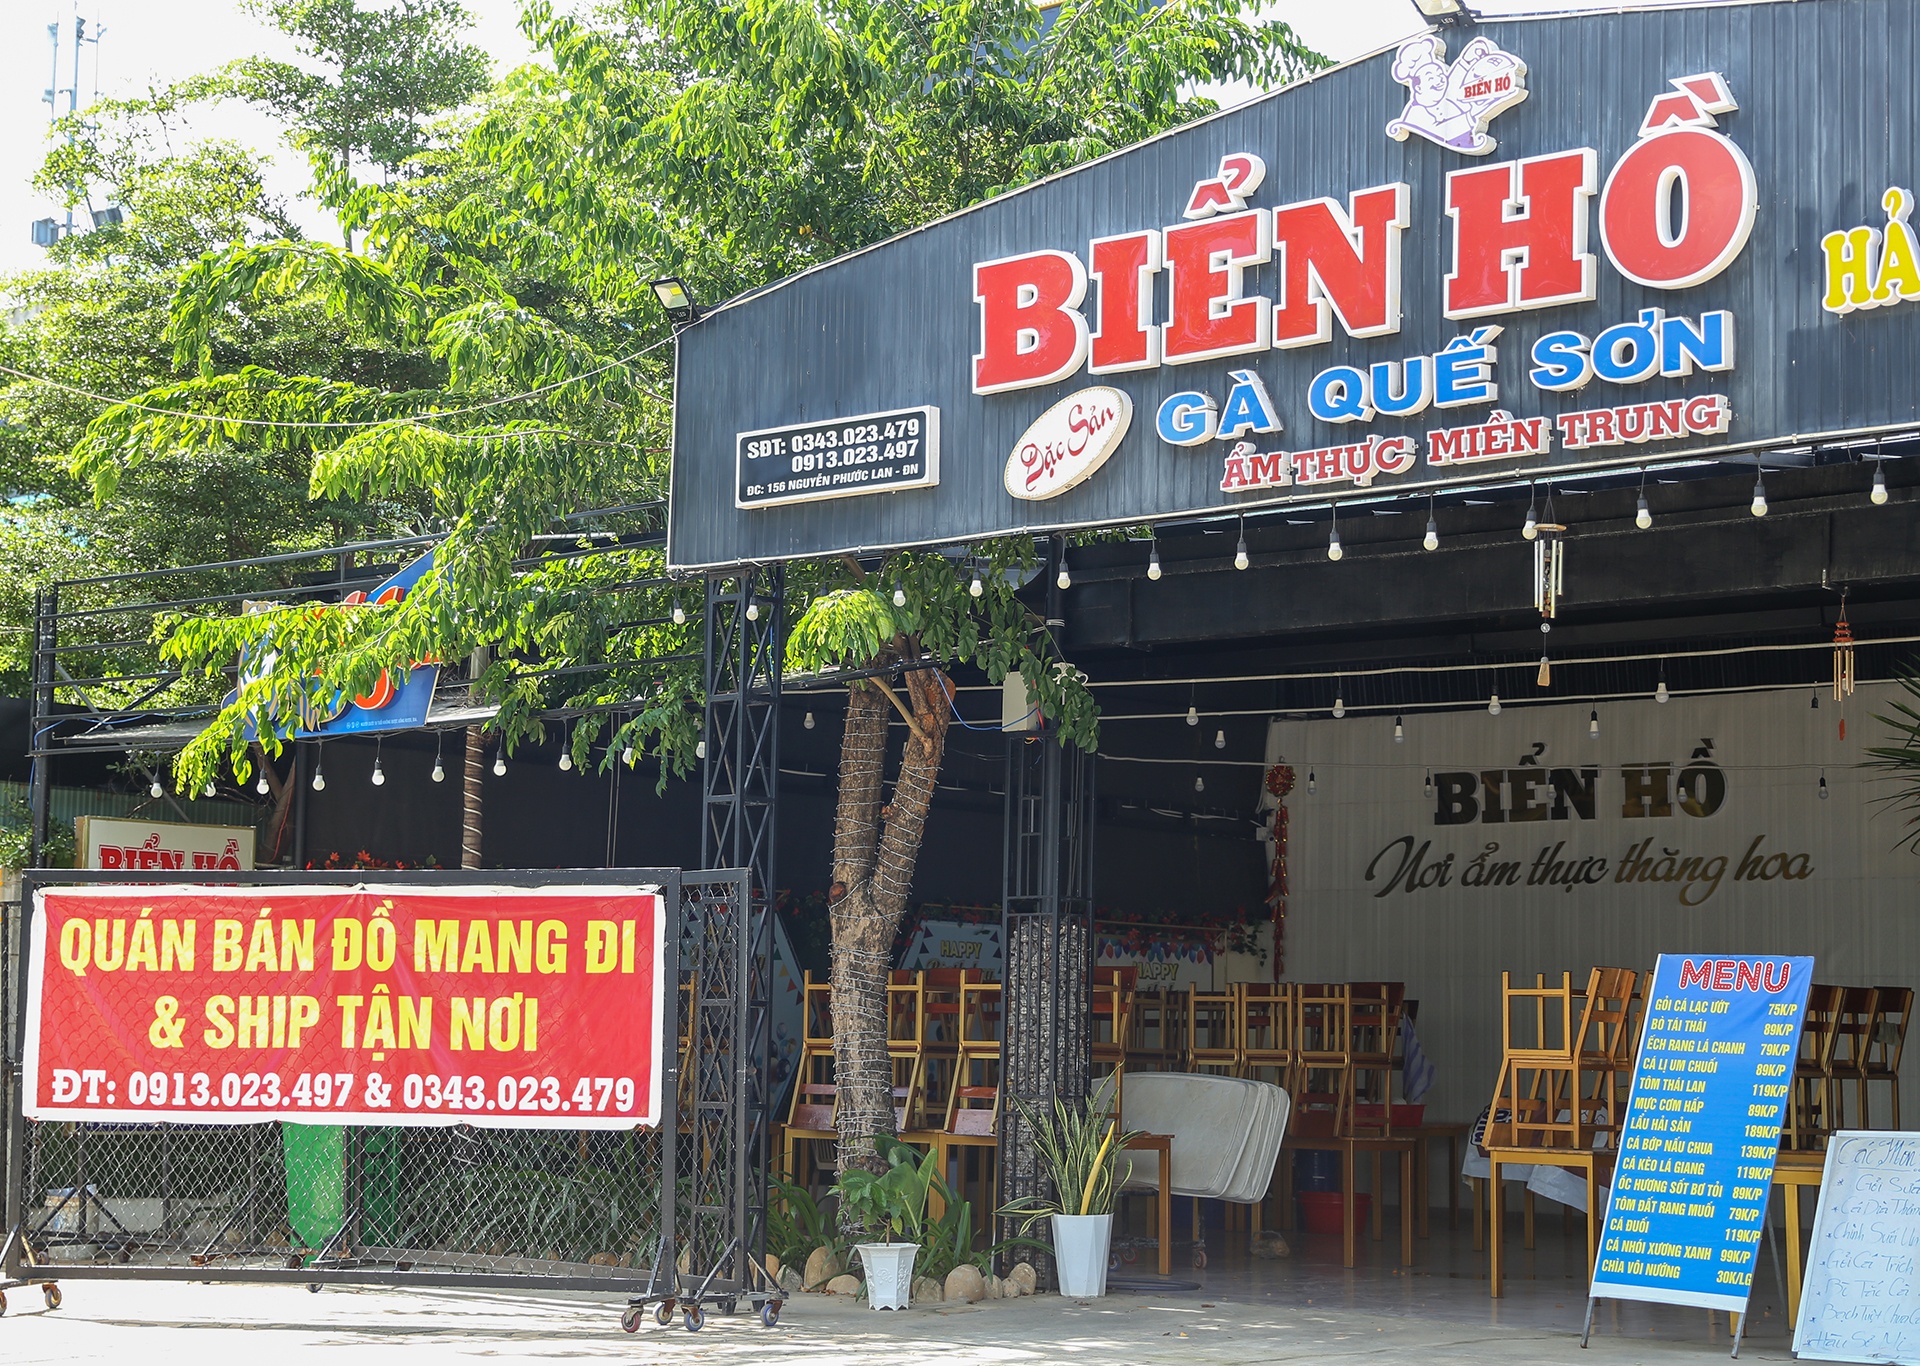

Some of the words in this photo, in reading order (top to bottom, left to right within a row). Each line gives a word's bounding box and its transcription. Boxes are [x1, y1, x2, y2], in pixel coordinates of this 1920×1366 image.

[1464, 77, 1492, 98] BIỂN
[972, 152, 1411, 396] BIỂN
[1444, 71, 1758, 320] HỒ
[1156, 369, 1283, 447] GÀ
[1307, 324, 1504, 423] QUẾ
[1529, 307, 1734, 392] SƠN
[747, 437, 786, 459] SĐT:
[791, 418, 919, 453] 0343.023.479
[1020, 438, 1065, 492] Đặc
[1068, 403, 1115, 457] Sản
[1220, 442, 1292, 493] ẨM
[1291, 434, 1416, 487] THỰC
[1427, 409, 1551, 467] MIỀN
[1557, 394, 1731, 450] TRUNG
[791, 439, 919, 473] 0913.023.497
[747, 485, 764, 497] ĐC:
[766, 481, 786, 494] 156
[833, 468, 869, 485] PHƯỚC
[871, 467, 893, 480] LAN
[902, 463, 919, 476] ĐN
[1434, 742, 1600, 826] BIỂN
[1622, 737, 1728, 819] HỒ
[99, 832, 185, 886] BIỂN
[192, 839, 241, 886] HỒ
[1364, 835, 1454, 898] Nơi
[1460, 841, 1522, 888] ẩm
[1526, 840, 1609, 893] thực
[1614, 836, 1729, 907] thăng
[1734, 834, 1815, 882] hoa
[60, 907, 197, 977] QUÁN
[213, 908, 316, 974] BÁN
[332, 898, 396, 973] ĐỒ
[414, 919, 568, 976] MANG
[584, 919, 636, 975] ĐI
[941, 940, 983, 959] HAPPY
[1679, 959, 1791, 993] MENU
[1655, 995, 1672, 1011] GỎI
[1674, 998, 1687, 1012] CÁ
[1689, 1000, 1708, 1015] LẠC
[1710, 998, 1730, 1014] ƯỚT
[1768, 1003, 1798, 1017] 75K/P
[148, 995, 186, 1051] &
[204, 993, 319, 1050] SHIP
[337, 983, 432, 1062] TẬN
[449, 991, 538, 1052] NƠI
[1651, 1016, 1665, 1030] BÒ
[1667, 1017, 1683, 1031] TÁI
[1684, 1019, 1707, 1033] THÁI
[1763, 1023, 1794, 1036] 89K/P
[1647, 1034, 1666, 1050] ẾCH
[1668, 1038, 1695, 1052] RANG
[1696, 1039, 1709, 1053] LÁ
[1711, 1041, 1746, 1055] CHANH
[1760, 1043, 1790, 1057] 79K/P
[1643, 1056, 1656, 1070] CÁ
[1658, 1058, 1668, 1073] LỊ
[1669, 1059, 1686, 1072] UM
[1687, 1057, 1718, 1074] CHUỐI
[1756, 1063, 1786, 1077] 89K/P
[51, 1069, 117, 1105] ĐT:
[128, 1070, 355, 1108] 0913.023.497
[364, 1074, 393, 1108] &
[402, 1074, 636, 1113] 0343.023.479
[1640, 1075, 1661, 1091] TÔM
[1662, 1076, 1685, 1092] THÁI
[1686, 1080, 1706, 1093] LAN
[1752, 1083, 1788, 1098] 119K/P
[1634, 1096, 1658, 1112] MỰC
[1659, 1098, 1682, 1112] CƠM
[1683, 1096, 1705, 1113] HẤP
[1747, 1104, 1779, 1118] 89K/P
[1630, 1112, 1650, 1130] LẨU
[1650, 1115, 1669, 1131] HẢI
[1669, 1116, 1692, 1133] SẢN
[1744, 1124, 1781, 1139] 189K/P
[1626, 1135, 1640, 1150] CÁ
[1642, 1136, 1662, 1151] BỚP
[1664, 1136, 1686, 1153] NẤU
[1687, 1141, 1713, 1155] CHUA
[1740, 1145, 1777, 1160] 139K/P
[1838, 1138, 1877, 1165] Các
[1622, 1155, 1636, 1170] CÁ
[1638, 1156, 1657, 1172] KÈO
[1659, 1158, 1672, 1173] LÁ
[1674, 1161, 1705, 1175] GIANG
[1736, 1166, 1773, 1181] 119K/P
[1618, 1173, 1632, 1190] ỐC
[1633, 1178, 1668, 1193] HƯƠNG
[1669, 1178, 1690, 1194] SỐT
[1690, 1182, 1706, 1196] BƠ
[1707, 1181, 1724, 1198] TỎI
[1732, 1186, 1763, 1201] 89K/P
[1615, 1195, 1636, 1211] TÔM
[1637, 1196, 1657, 1213] ĐẤT
[1658, 1201, 1686, 1216] RANG
[1688, 1201, 1715, 1218] MUỐI
[1729, 1207, 1760, 1221] 79K/P
[1610, 1216, 1624, 1231] CÁ
[1625, 1216, 1650, 1233] ĐUỐI
[1725, 1228, 1761, 1243] 119K/P
[1606, 1236, 1619, 1251] CÁ
[1621, 1238, 1646, 1254] NHÓI
[1647, 1241, 1683, 1257] XƯƠNG
[1683, 1246, 1713, 1260] XANH
[1720, 1249, 1751, 1264] 99K/P
[1601, 1258, 1625, 1273] CHÌA
[1627, 1260, 1644, 1275] VÔI
[1645, 1262, 1681, 1279] NƯỚNG
[1716, 1270, 1752, 1286] 30K/LG
[1881, 1254, 1914, 1275] Trích
